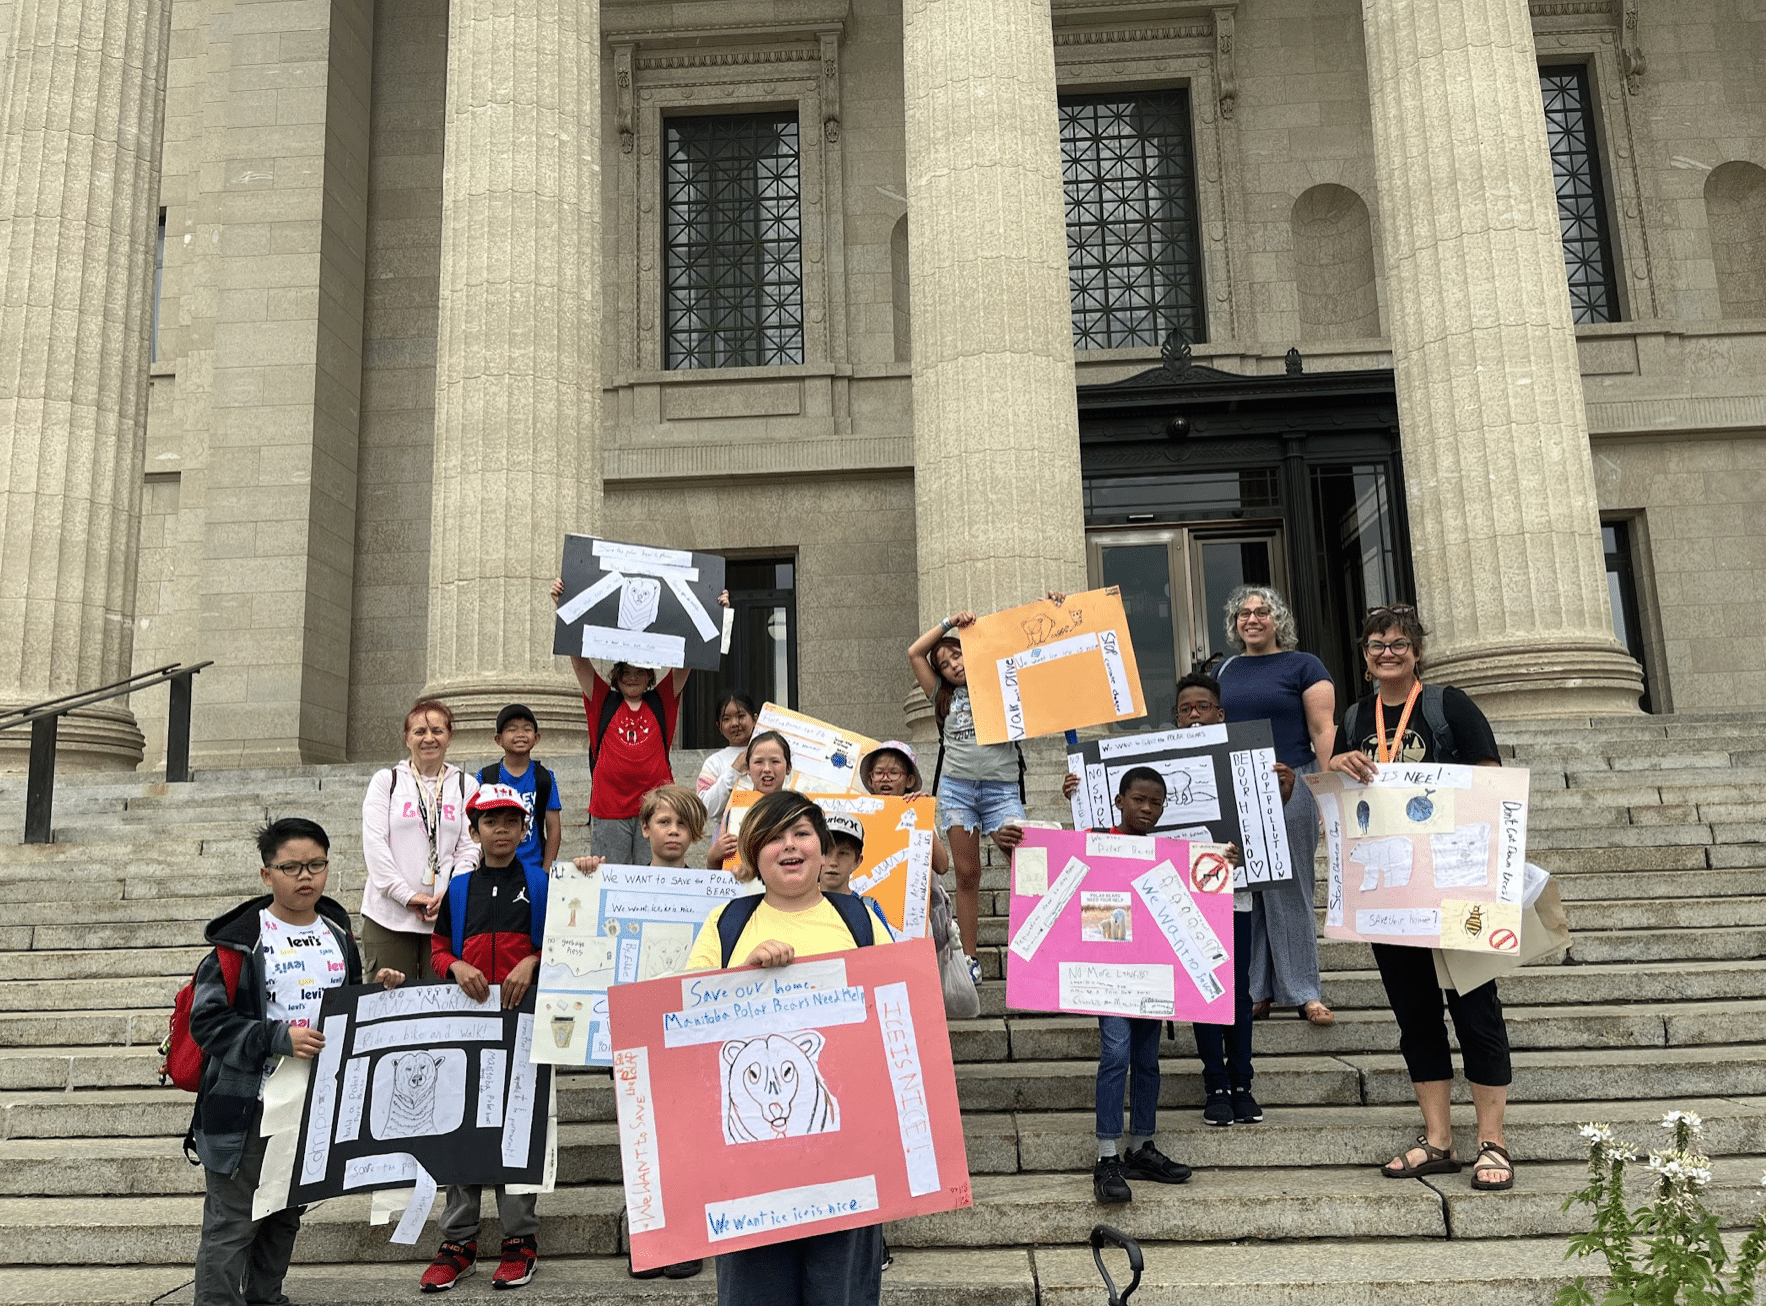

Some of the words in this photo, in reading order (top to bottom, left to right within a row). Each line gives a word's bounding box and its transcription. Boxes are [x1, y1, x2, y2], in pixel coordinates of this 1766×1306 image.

[1233, 752, 1249, 766] BE
[601, 869, 619, 884] We
[624, 873, 653, 884] WANT
[655, 874, 665, 885] to
[612, 902, 625, 913] We
[286, 935, 322, 948] levi's
[691, 980, 729, 1008] Save
[735, 981, 765, 998] our
[665, 1008, 731, 1031] Manitoba
[733, 1001, 767, 1019] Polar
[772, 997, 810, 1013] Bears
[812, 990, 840, 1006] Need
[841, 988, 866, 1004] Help
[403, 1024, 426, 1041] bike
[430, 1024, 451, 1040] and
[635, 1131, 648, 1147] to
[708, 1212, 730, 1235] We
[771, 1210, 787, 1226] ice
[792, 1207, 809, 1221] ice
[811, 1204, 823, 1218] is
